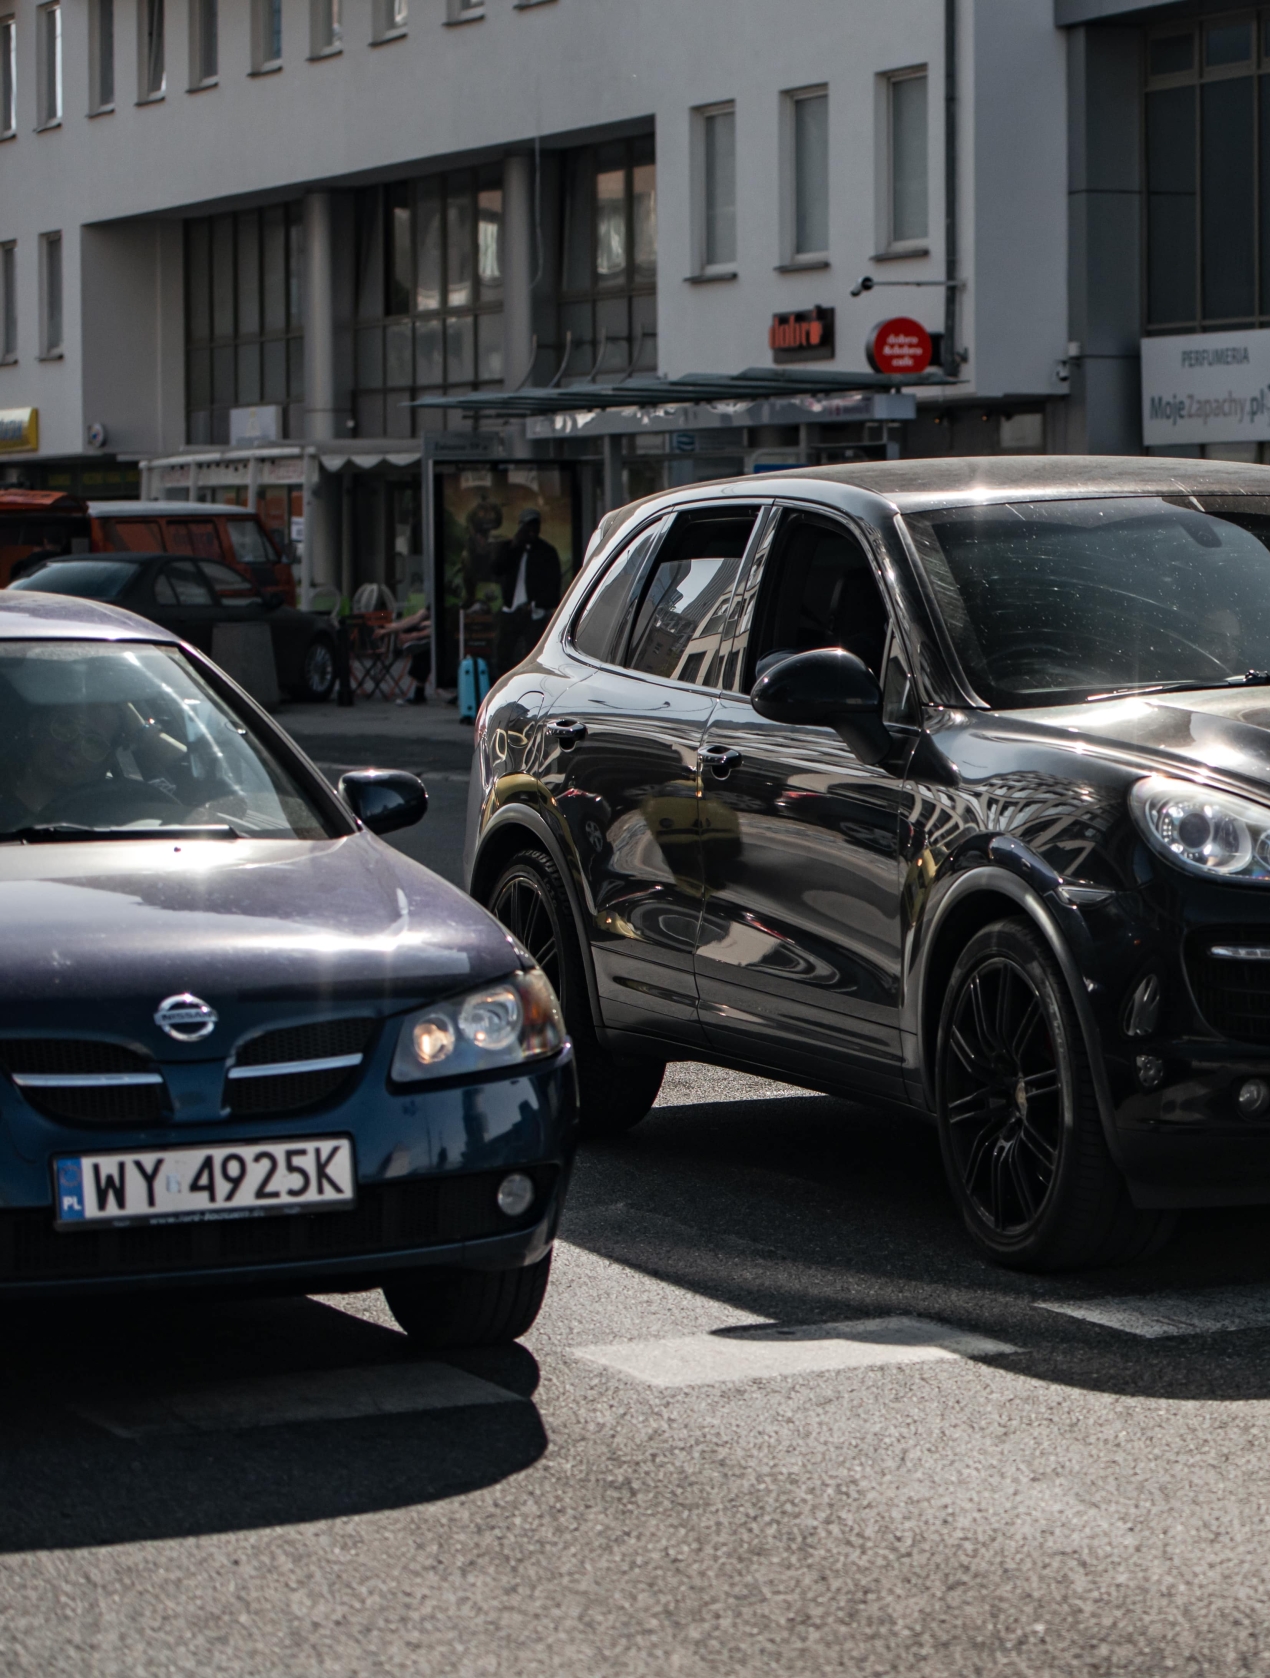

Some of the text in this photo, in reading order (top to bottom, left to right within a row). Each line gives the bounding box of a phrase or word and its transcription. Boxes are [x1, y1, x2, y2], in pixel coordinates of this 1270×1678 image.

[886, 333, 919, 345] dobro
[1181, 347, 1250, 368] PERFUMERIA
[1149, 388, 1265, 427] MojeZapachy.pl
[92, 1145, 345, 1212] WY 4925K
[62, 1195, 82, 1211] PL
